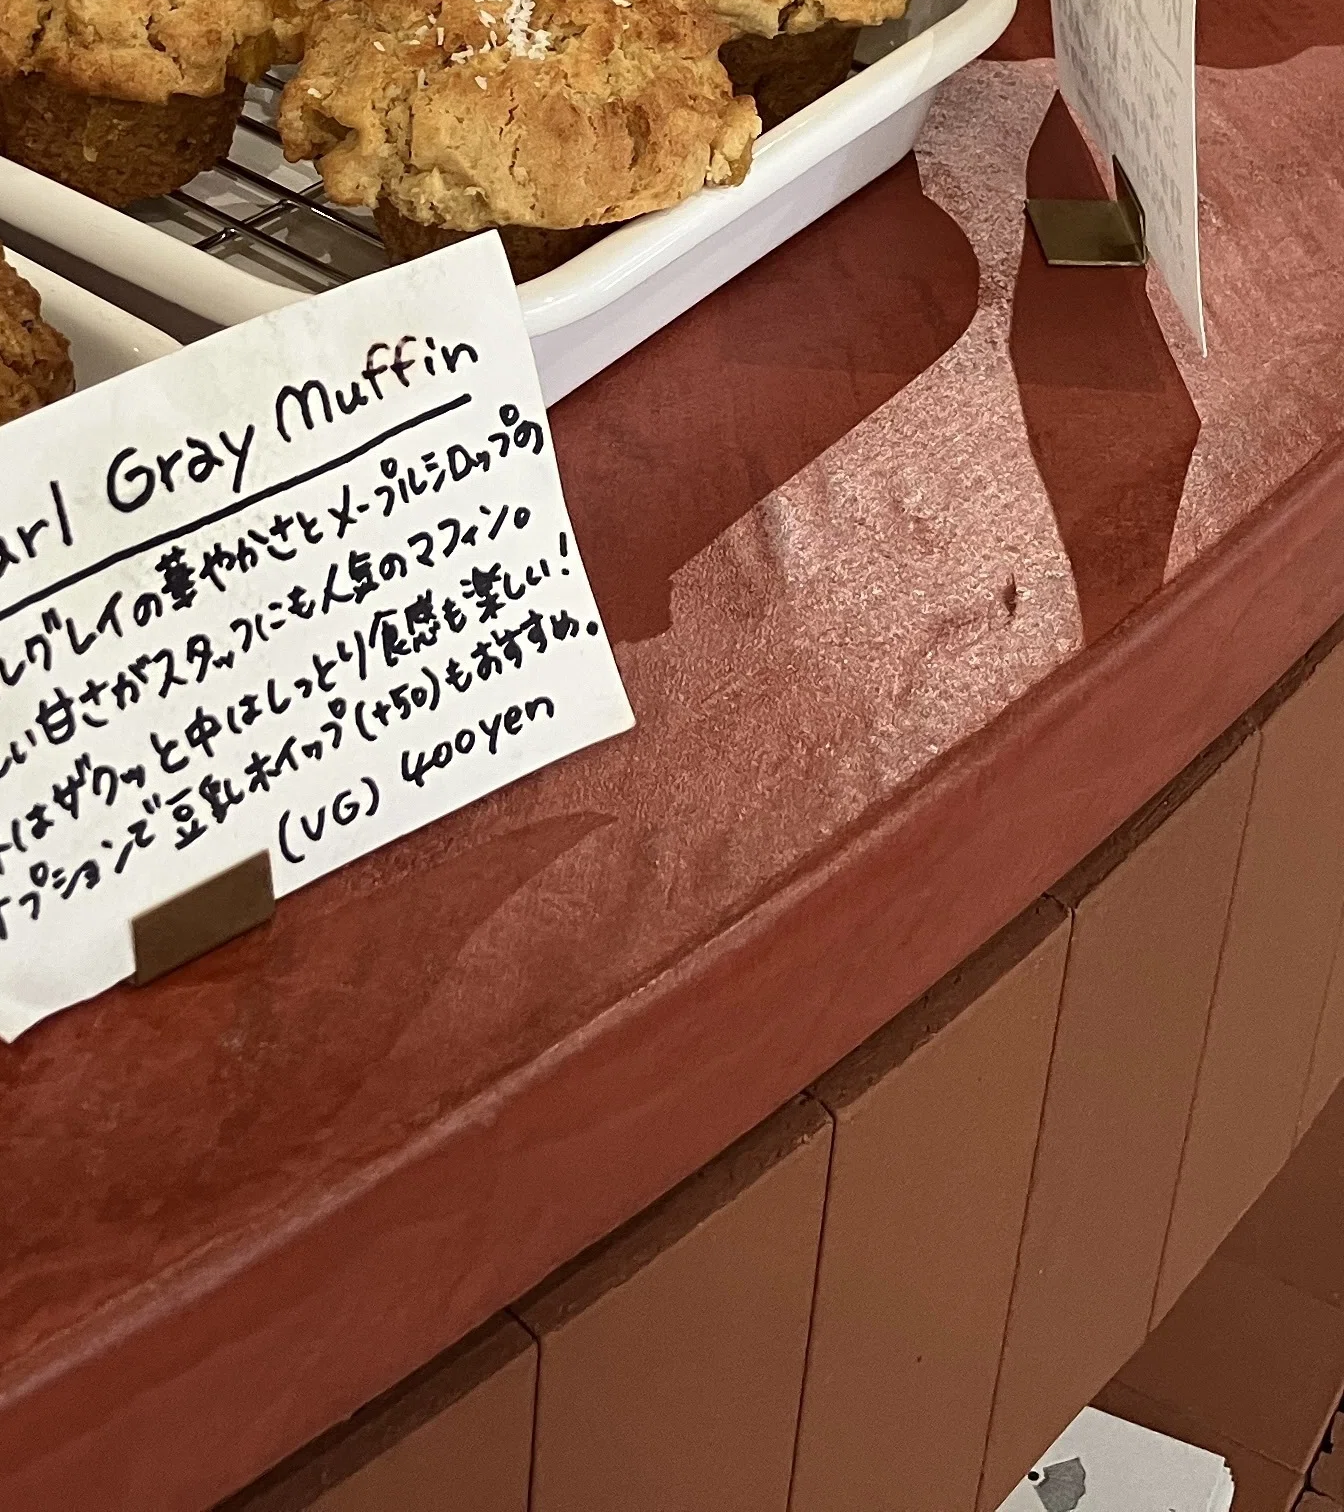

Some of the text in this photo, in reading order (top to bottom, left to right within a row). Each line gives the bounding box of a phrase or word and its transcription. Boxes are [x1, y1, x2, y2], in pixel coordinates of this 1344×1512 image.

[106, 423, 256, 515] Gray
[274, 334, 481, 445] Muffin
[276, 696, 556, 863] (VG) 400yen
